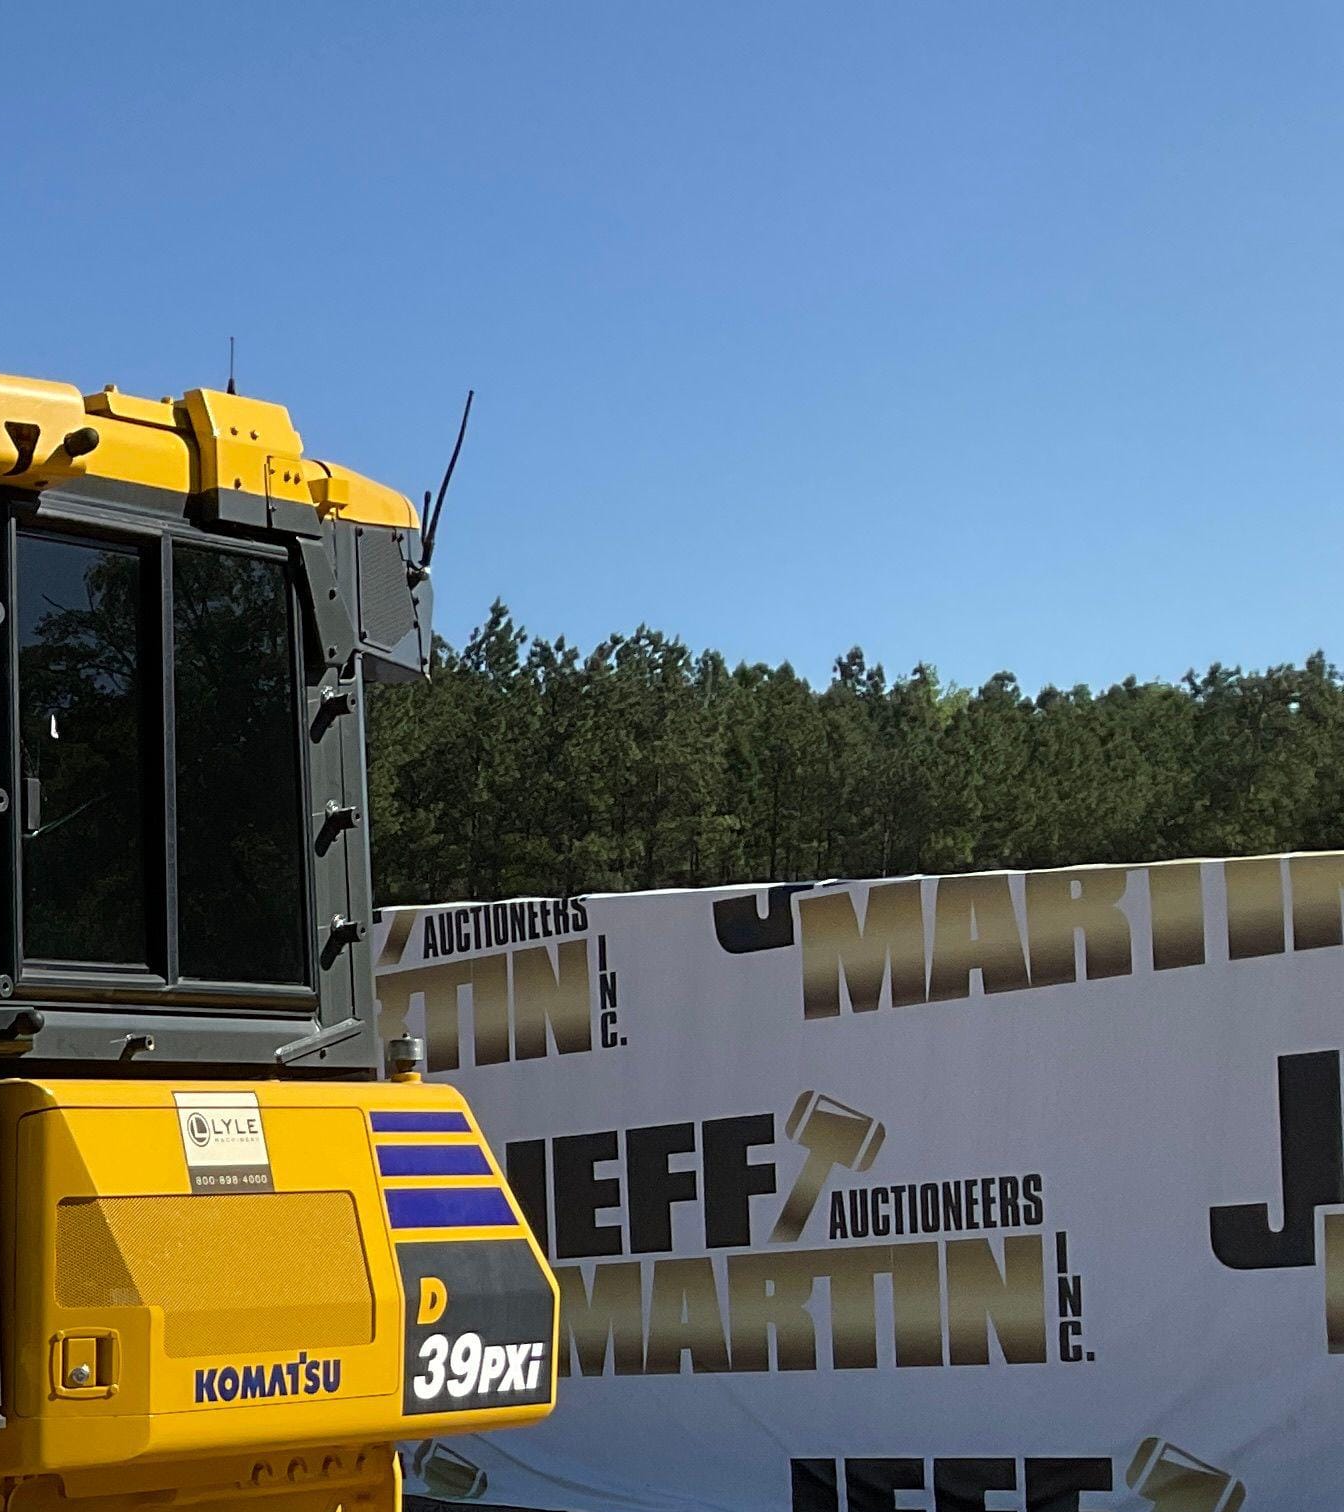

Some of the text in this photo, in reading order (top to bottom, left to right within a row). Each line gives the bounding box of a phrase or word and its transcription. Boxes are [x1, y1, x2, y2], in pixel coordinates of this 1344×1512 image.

[423, 897, 589, 960] AUCTIONEERS
[211, 1118, 259, 1135] LYLE
[829, 1174, 1044, 1239] AUCTIONEERS
[417, 1276, 448, 1325] D
[195, 1351, 342, 1403] KOMATSU
